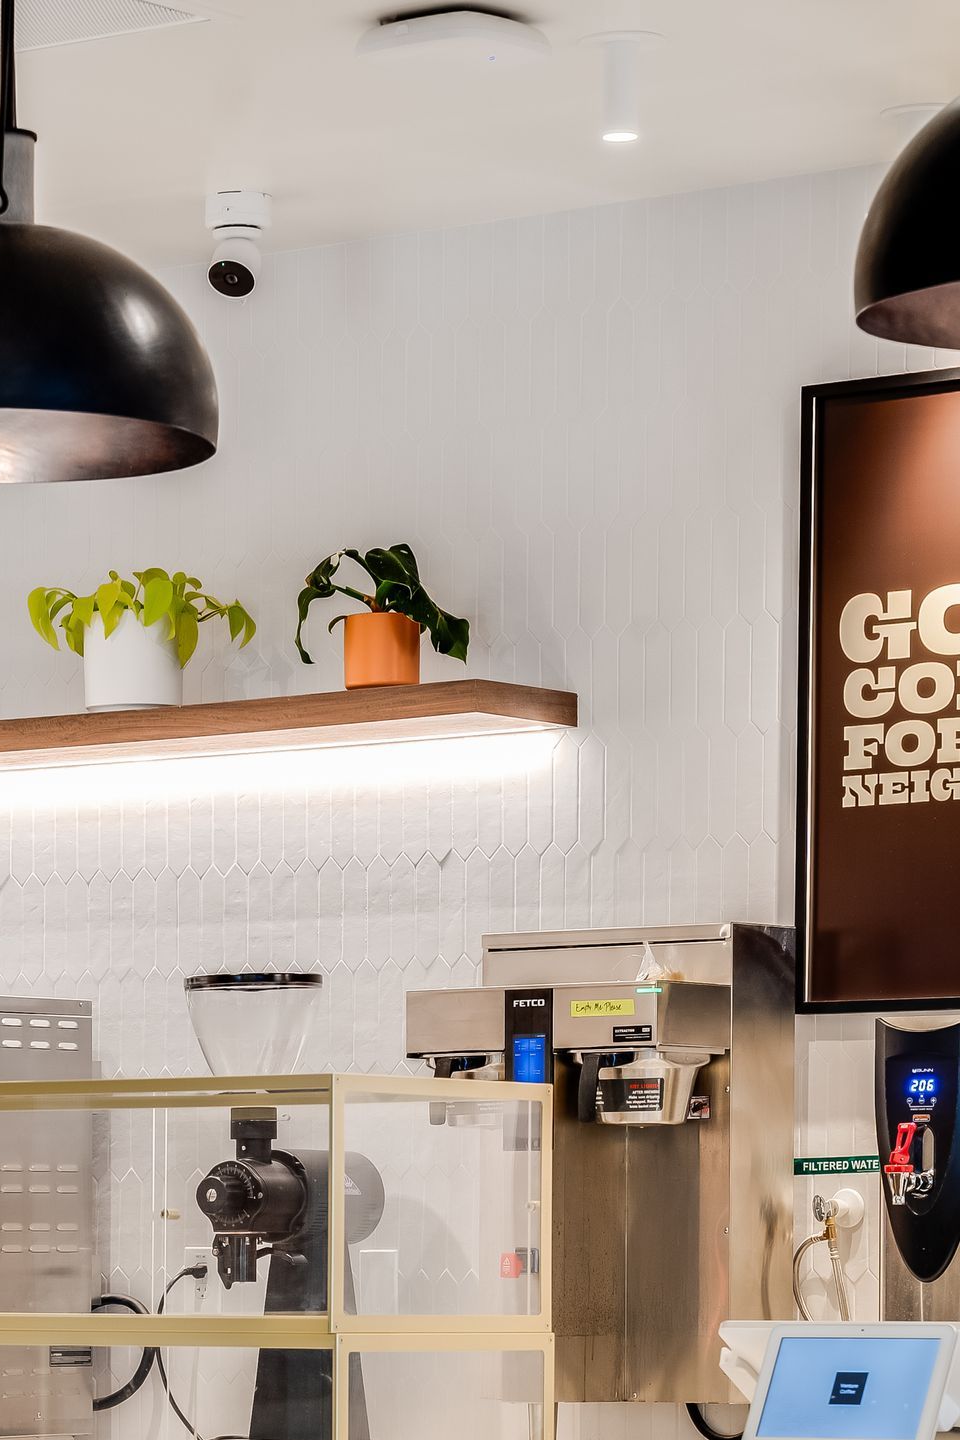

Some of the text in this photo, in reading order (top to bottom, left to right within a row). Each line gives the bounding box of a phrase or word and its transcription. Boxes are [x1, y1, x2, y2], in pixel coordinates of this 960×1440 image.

[843, 660, 960, 719] CO
[513, 999, 545, 1008] FETCO
[910, 1079, 934, 1092] 206
[803, 1161, 849, 1171] FILTERED
